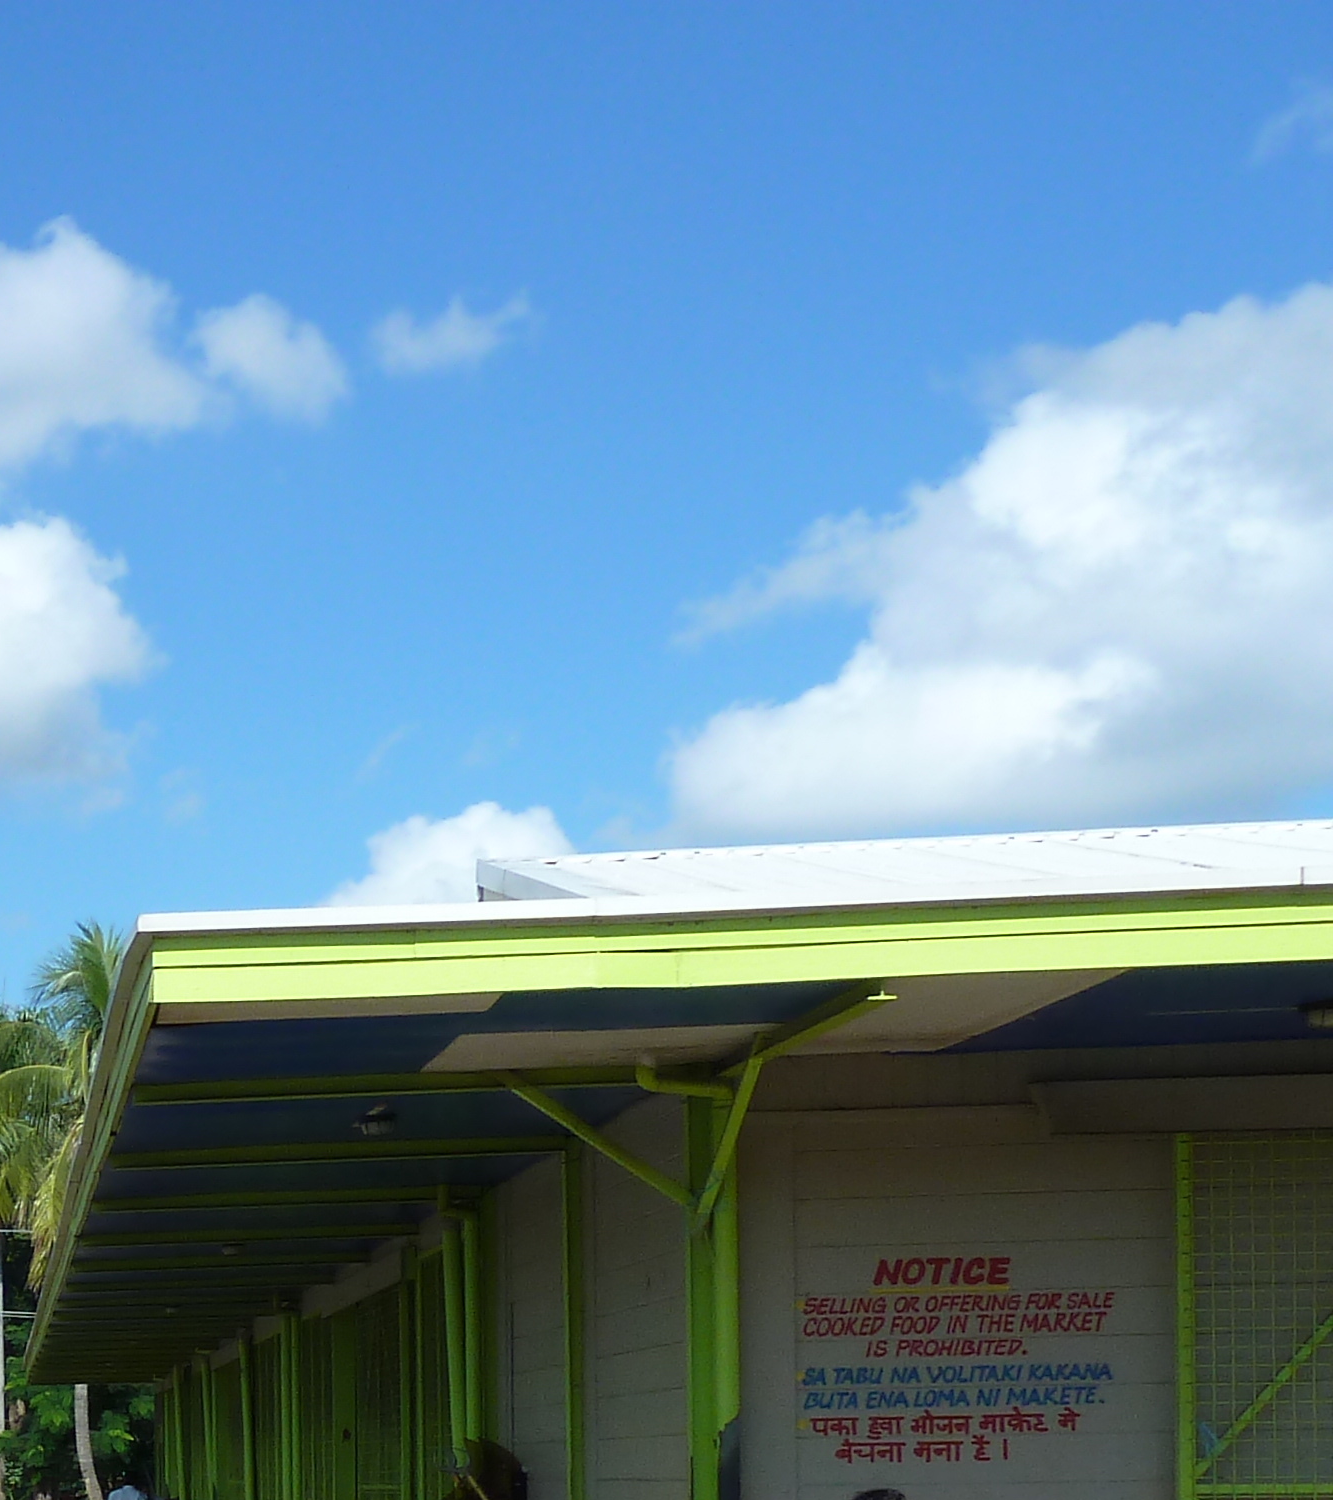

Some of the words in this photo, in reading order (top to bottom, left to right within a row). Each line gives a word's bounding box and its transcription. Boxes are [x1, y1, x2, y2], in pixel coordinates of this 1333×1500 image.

[873, 1257, 1011, 1285] NOTICE
[803, 1297, 887, 1315] SELLING
[894, 1296, 920, 1313] OR
[925, 1294, 1021, 1313] OFFERING
[1024, 1292, 1063, 1310] FOR
[1067, 1291, 1115, 1310] SALE
[803, 1316, 886, 1337] COOKED
[890, 1315, 941, 1335] FOOD
[947, 1314, 968, 1334] IN
[977, 1313, 1016, 1333] THE
[1019, 1311, 1107, 1333] MARKET
[866, 1340, 889, 1358] IS
[896, 1338, 1028, 1357] PROHIBITED.
[802, 1366, 827, 1386] SA
[833, 1366, 883, 1384] TABU
[891, 1366, 922, 1384] NA
[926, 1364, 1024, 1384] VOLITAKI
[1027, 1362, 1114, 1381] KAKANA
[803, 1391, 859, 1410] BUTA
[866, 1390, 909, 1409] ENA
[913, 1389, 970, 1408] LOMA
[976, 1388, 1001, 1407] NI
[1006, 1386, 1105, 1406] MAKETE.
[913, 1440, 964, 1463] मना
